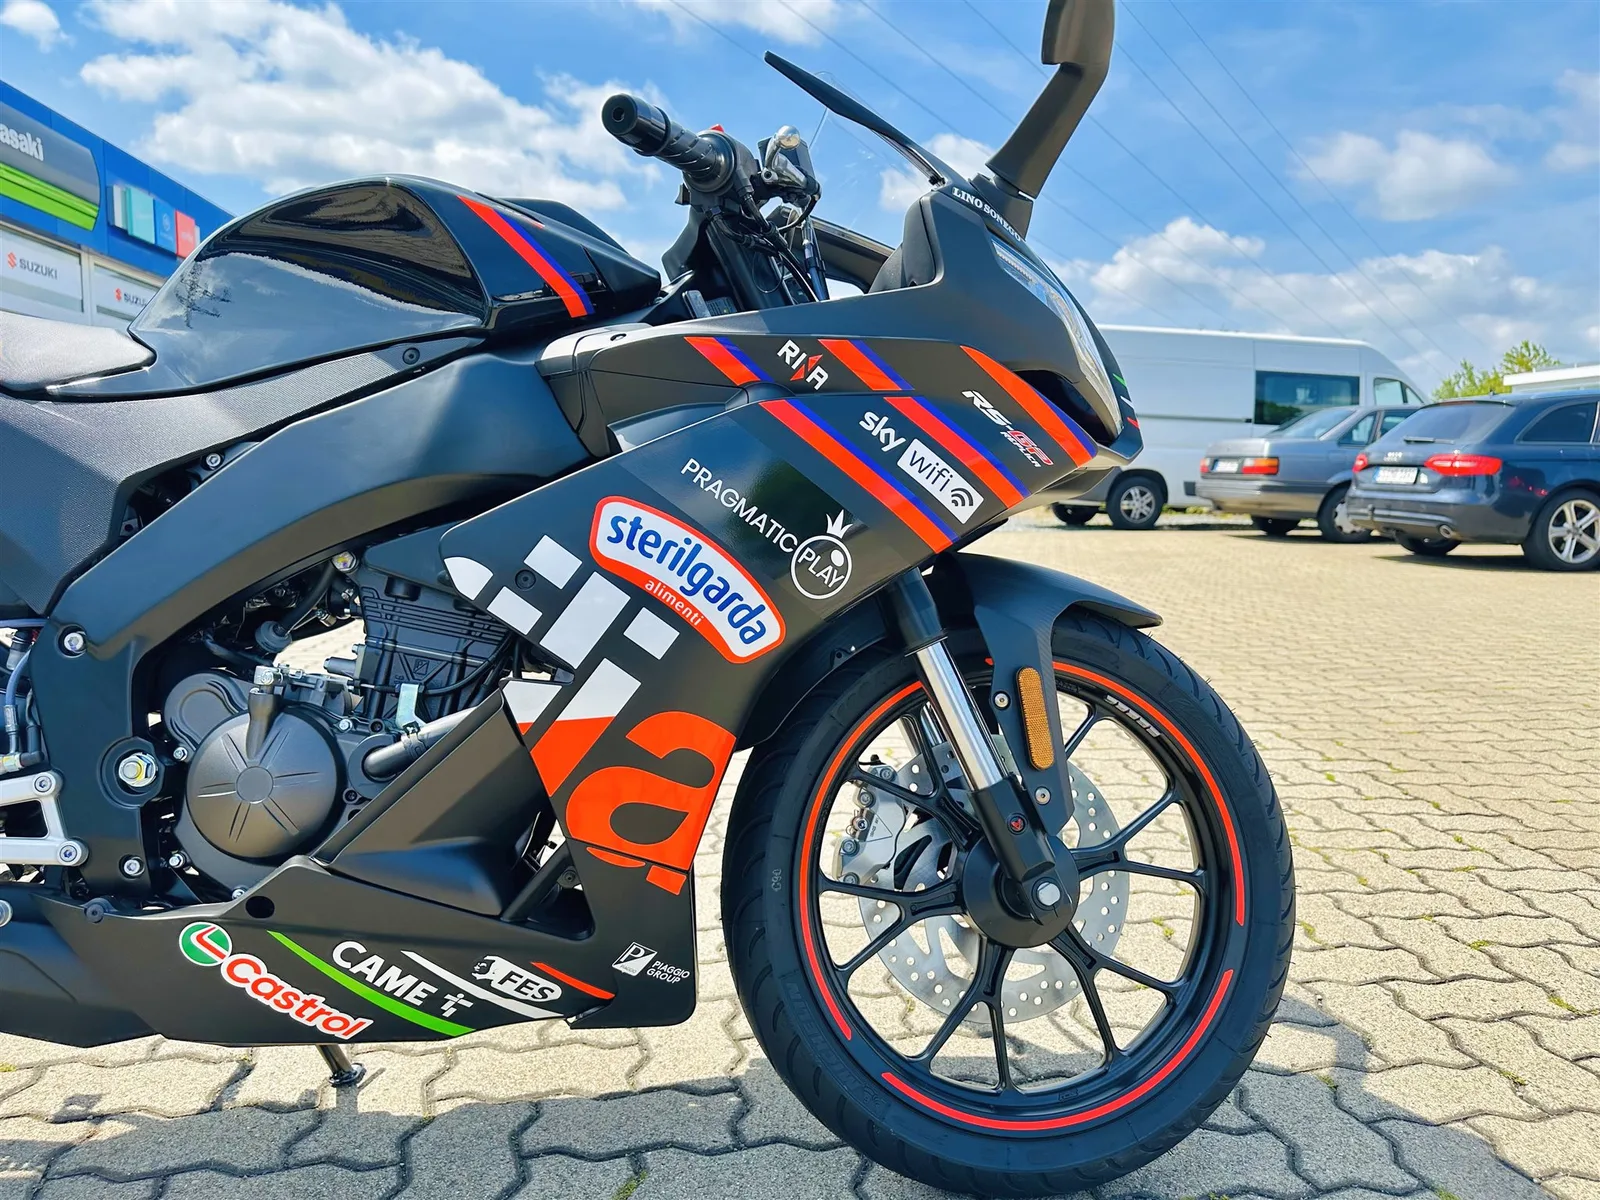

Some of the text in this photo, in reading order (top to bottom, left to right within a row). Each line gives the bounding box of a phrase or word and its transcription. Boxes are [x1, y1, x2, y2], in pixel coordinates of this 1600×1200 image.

[952, 186, 983, 209] LINO
[19, 258, 58, 280] SUZUKI
[124, 293, 147, 307] SUZU
[859, 411, 953, 492] sky wifi
[680, 458, 798, 553] PRAGMATIC
[606, 515, 767, 645] sterilgarda
[798, 547, 845, 590] PLAY
[645, 580, 706, 626] alimenti
[332, 940, 439, 1006] CAME
[498, 970, 555, 1000] FES
[646, 967, 681, 984] GROUP
[652, 960, 690, 979] PIAGGIO
[223, 955, 371, 1038] Castrol
